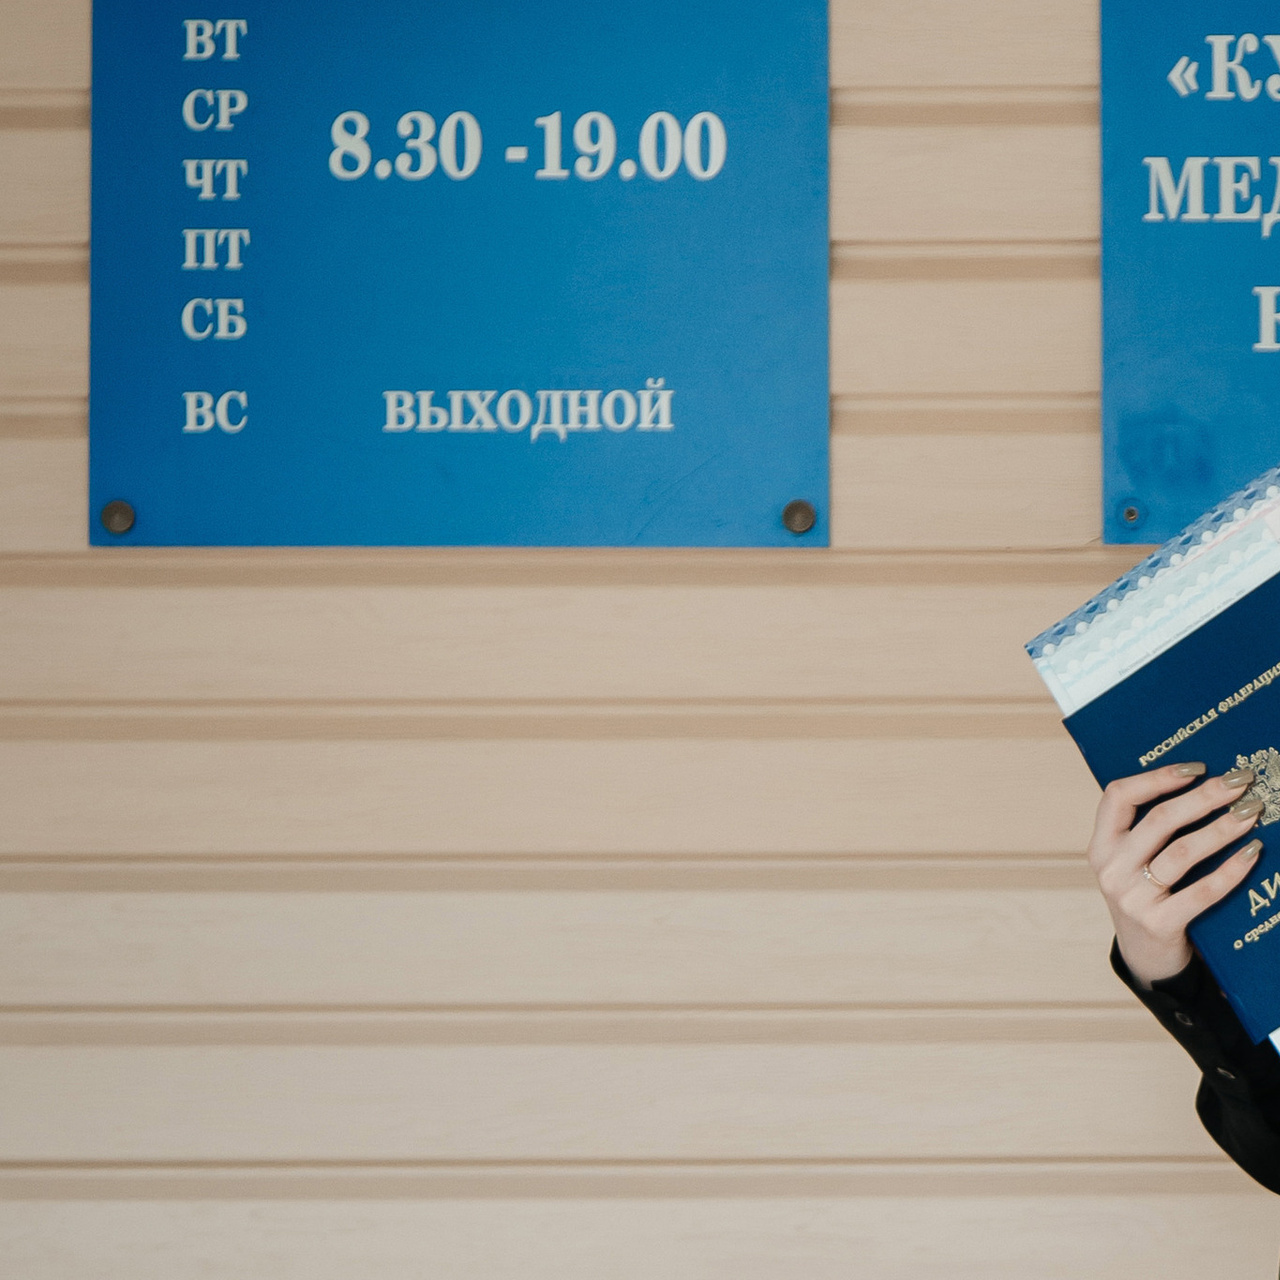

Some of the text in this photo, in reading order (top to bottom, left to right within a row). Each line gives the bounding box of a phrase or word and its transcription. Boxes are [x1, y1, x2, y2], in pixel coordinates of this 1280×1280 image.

[183, 19, 248, 61] ВТ
[182, 88, 249, 131] СР
[328, 110, 728, 181] 8.30 -19.00
[183, 158, 249, 201] ЧТ
[183, 229, 251, 270] ПТ
[181, 297, 248, 340] СБ
[182, 377, 675, 442] ВС ВЫХОДНОЙ
[1138, 707, 1219, 768] РОССИЙСКАЯ
[1233, 939, 1244, 950] о
